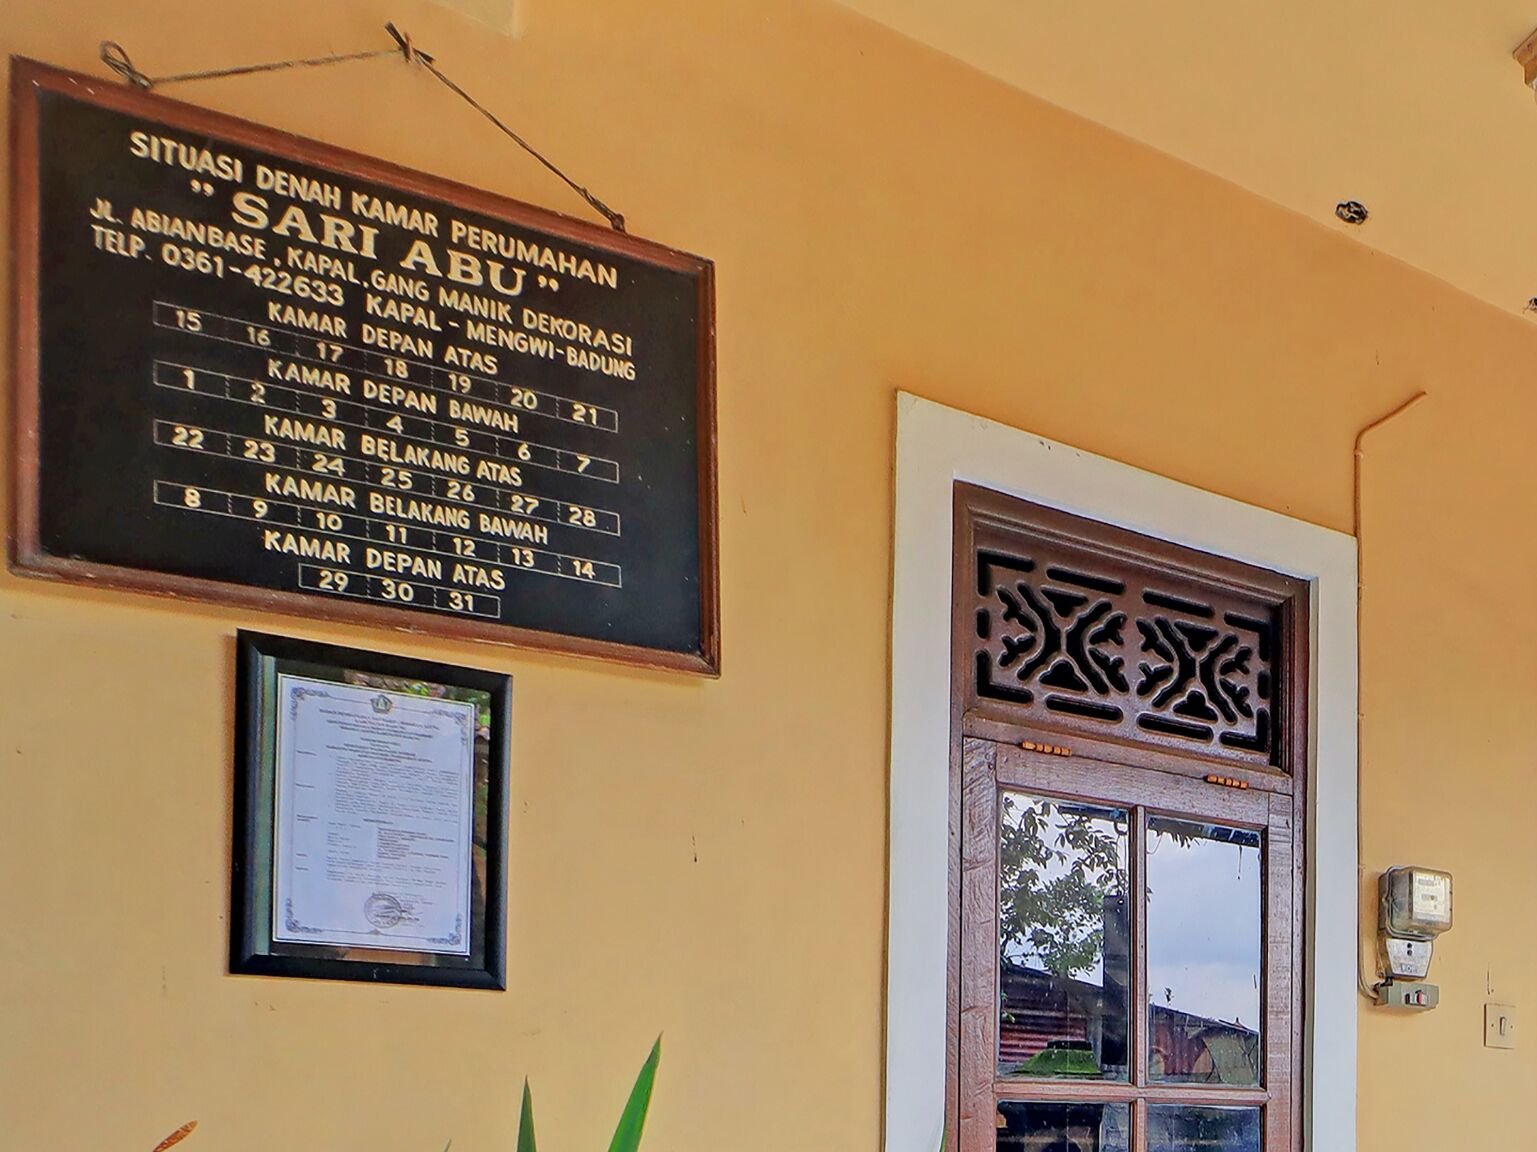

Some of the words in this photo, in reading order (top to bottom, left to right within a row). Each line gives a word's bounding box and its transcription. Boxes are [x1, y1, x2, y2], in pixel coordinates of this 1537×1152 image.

[130, 131, 243, 183] SITUASI
[256, 164, 341, 210] DENAH
[351, 191, 438, 238] KAMAR
[451, 219, 618, 289] PERUMAHAN
[231, 191, 380, 260] SARI
[400, 239, 527, 296] ABU
[89, 197, 123, 224] JL.
[439, 287, 513, 324] MANIK
[523, 308, 632, 357] DEKORASI
[91, 225, 152, 261] TELP.
[161, 243, 345, 307] 0361-422633
[366, 293, 442, 332] KAPAL
[175, 310, 202, 332] 15
[246, 326, 271, 346] 16
[316, 341, 343, 362] 17
[383, 358, 408, 379] 18
[449, 373, 471, 394] 19
[510, 387, 538, 410] 20
[572, 403, 597, 426] 21
[267, 301, 347, 338] KAMAR
[362, 323, 433, 359] DEPAN
[445, 345, 498, 375] ATAS
[183, 368, 195, 390] 1
[250, 381, 266, 404] 2
[321, 398, 337, 420] 3
[386, 415, 404, 434] 4
[454, 428, 470, 447] 5
[518, 442, 531, 461] 6
[575, 455, 591, 474] 7
[267, 358, 350, 395] KAMAR
[363, 379, 437, 414] DEPAN
[450, 399, 518, 434] BAWAH
[172, 426, 204, 450] 22
[243, 440, 276, 463] 23
[311, 453, 345, 477] 24
[380, 467, 413, 490] 25
[446, 480, 475, 502] 26
[510, 494, 539, 515] 27
[569, 506, 597, 528] 28
[264, 414, 346, 450] KAMAR
[361, 434, 470, 475] BELAKANG
[476, 460, 523, 487] ATAS
[184, 487, 201, 508] 8
[252, 500, 268, 518] 9
[316, 511, 343, 531] 10
[385, 524, 407, 545] 11
[453, 537, 476, 558] 12
[511, 547, 535, 568] 13
[572, 559, 596, 580] 14
[265, 472, 356, 509] KAMAR
[369, 492, 470, 530] BELAKANG
[479, 513, 548, 545] BAWAH
[263, 529, 351, 565] KAMAR
[366, 548, 442, 581] DEPAN
[452, 563, 506, 591] ATAS
[319, 570, 349, 592] 29
[381, 579, 414, 602] 30
[449, 592, 474, 612] 31
